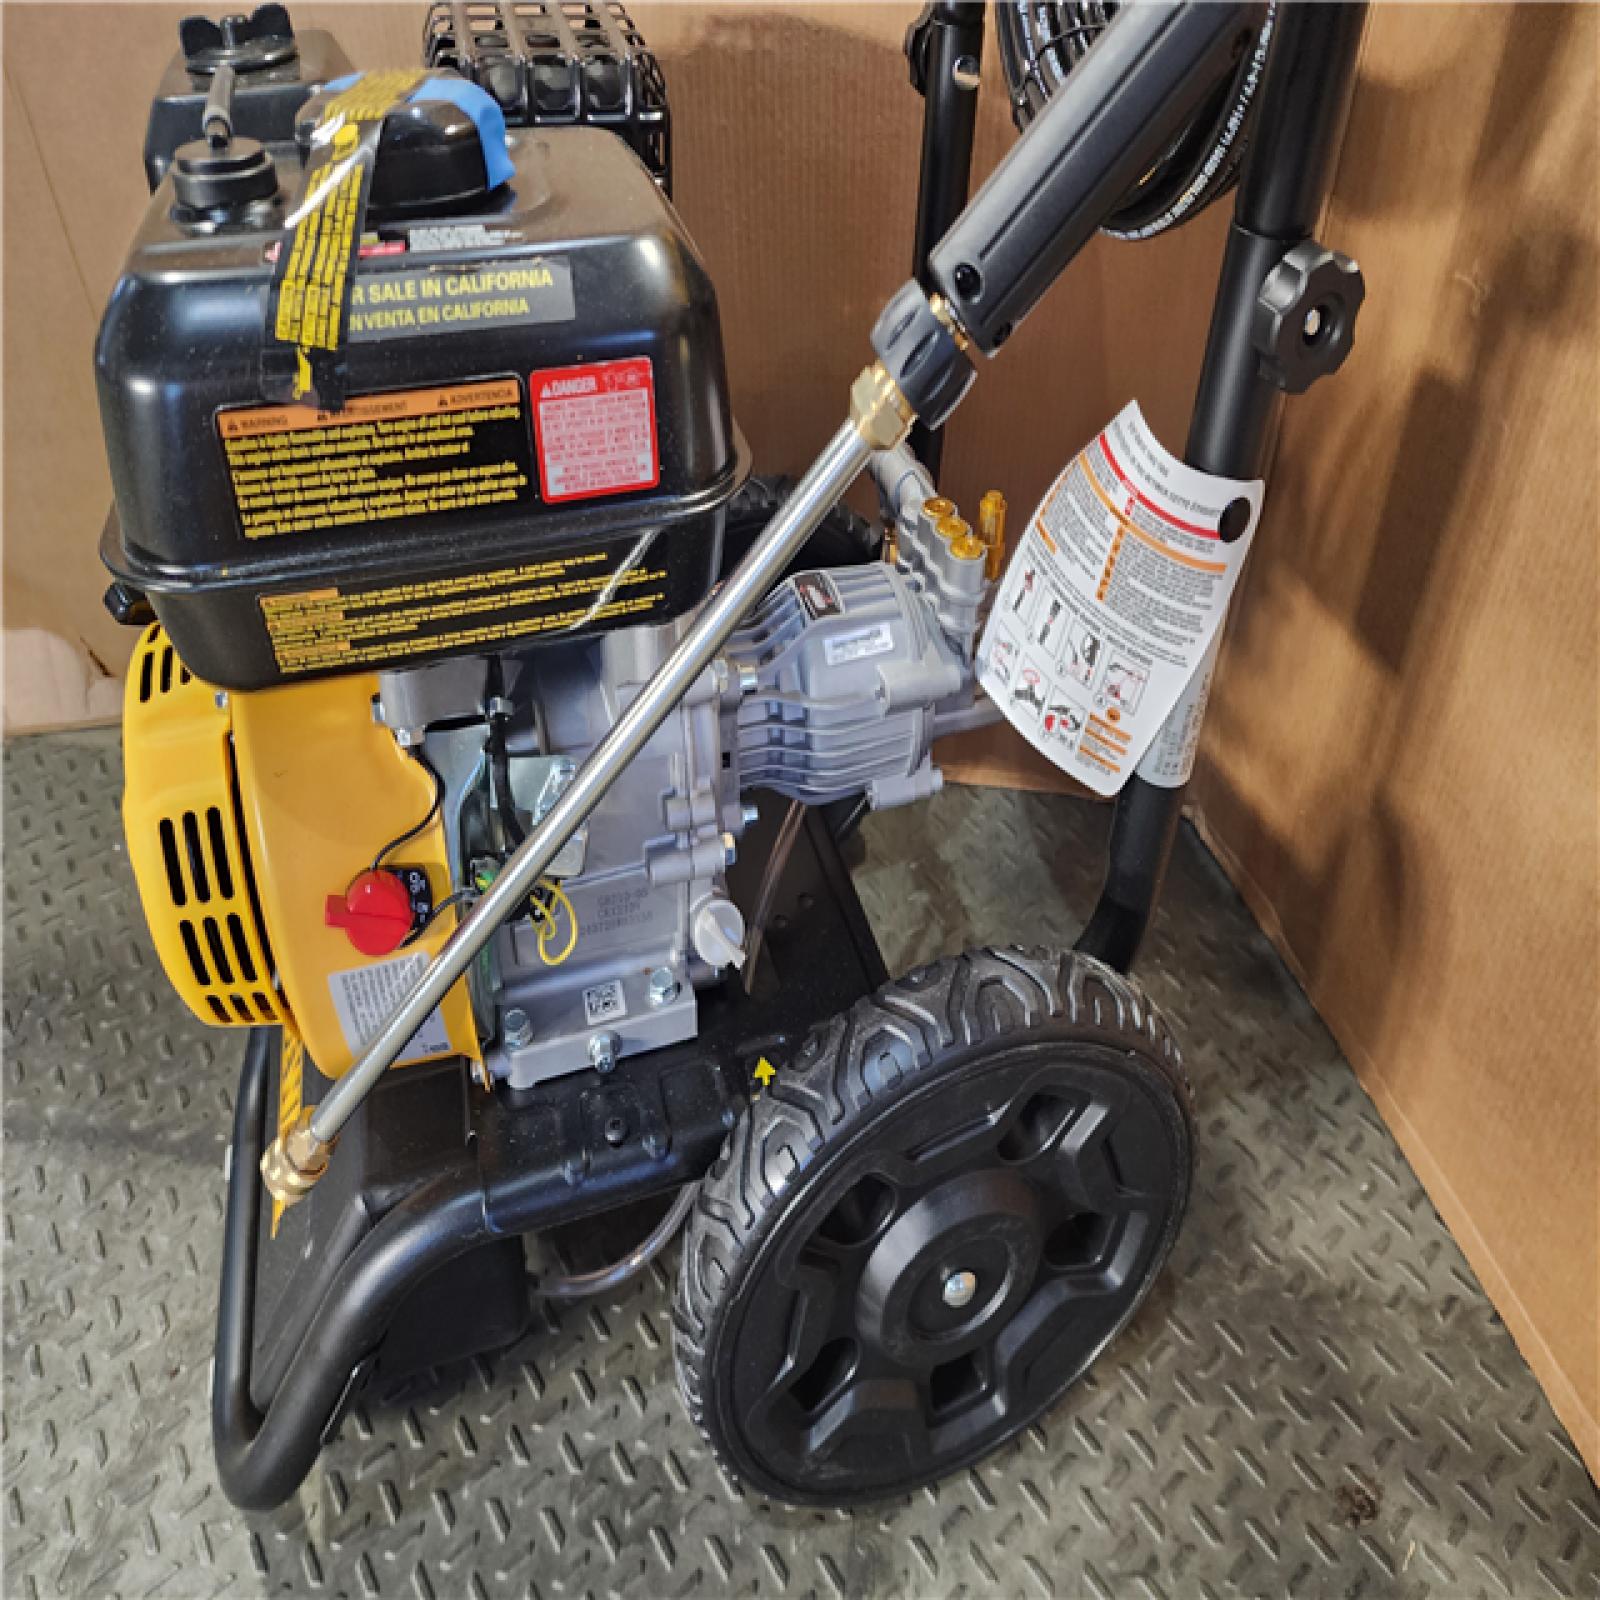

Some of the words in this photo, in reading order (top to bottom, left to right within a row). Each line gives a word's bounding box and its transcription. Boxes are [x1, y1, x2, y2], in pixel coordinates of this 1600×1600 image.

[368, 279, 416, 302] SALE
[420, 276, 441, 298] IN
[445, 268, 553, 296] CALIFORNIA
[365, 308, 416, 330] VENTA
[417, 305, 440, 323] EN
[442, 296, 530, 320] CALIFORNIA
[551, 375, 597, 395] DANGER
